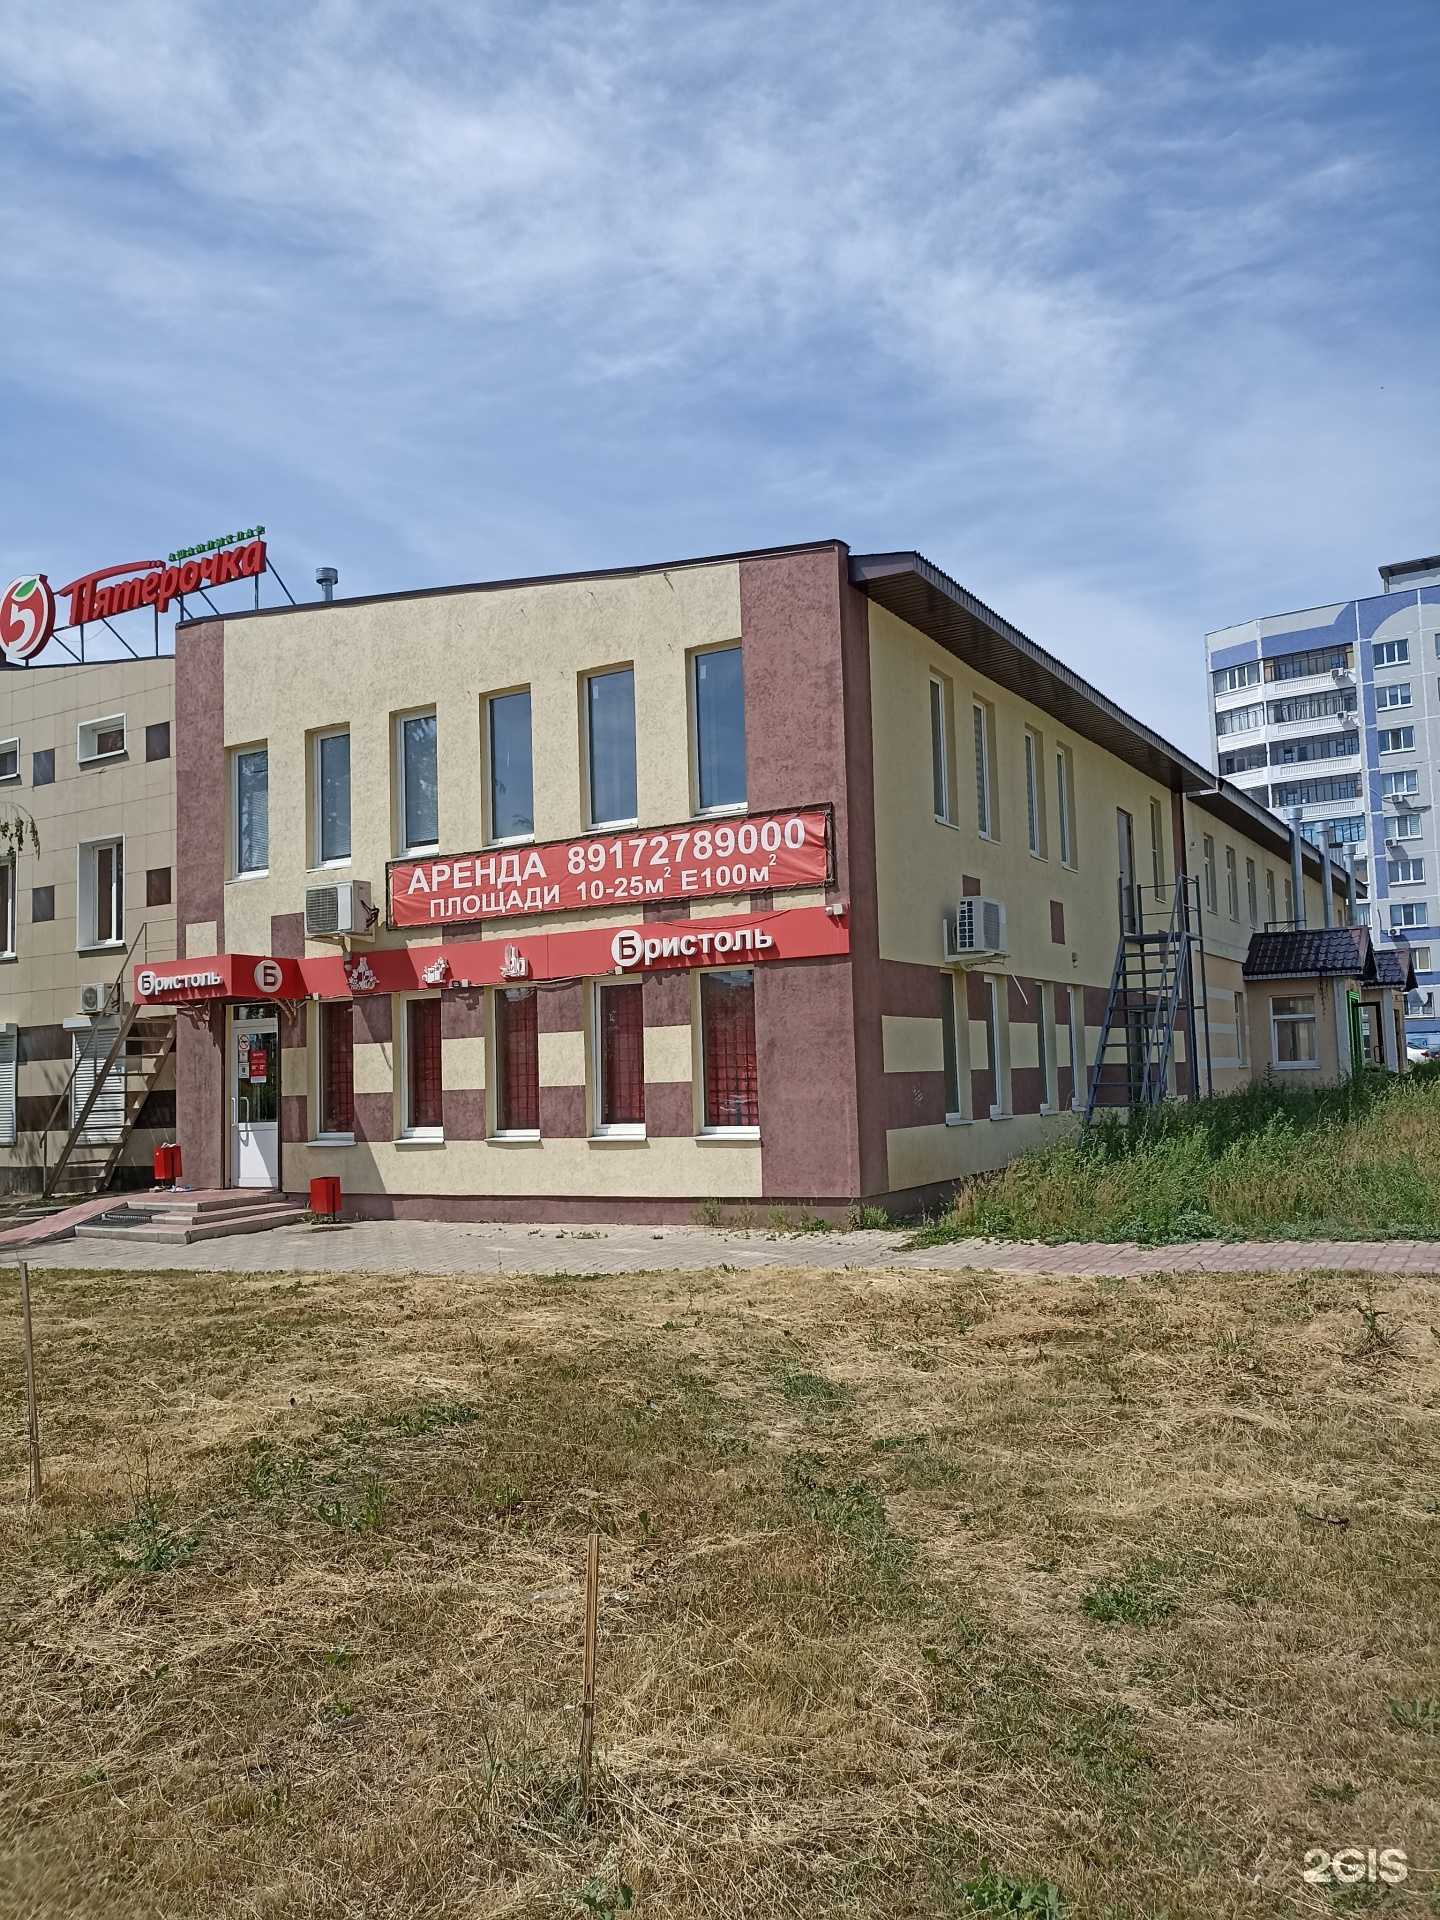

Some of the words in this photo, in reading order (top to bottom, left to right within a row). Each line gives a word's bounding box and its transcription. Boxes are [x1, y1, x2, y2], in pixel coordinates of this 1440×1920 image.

[407, 852, 547, 895] АРЕНДА
[567, 818, 806, 875] 89172789000
[430, 884, 560, 918] ПЛОЩАДИ
[611, 928, 774, 967] Бристоль
[137, 970, 222, 996] Бристоль
[260, 964, 280, 989] Б
